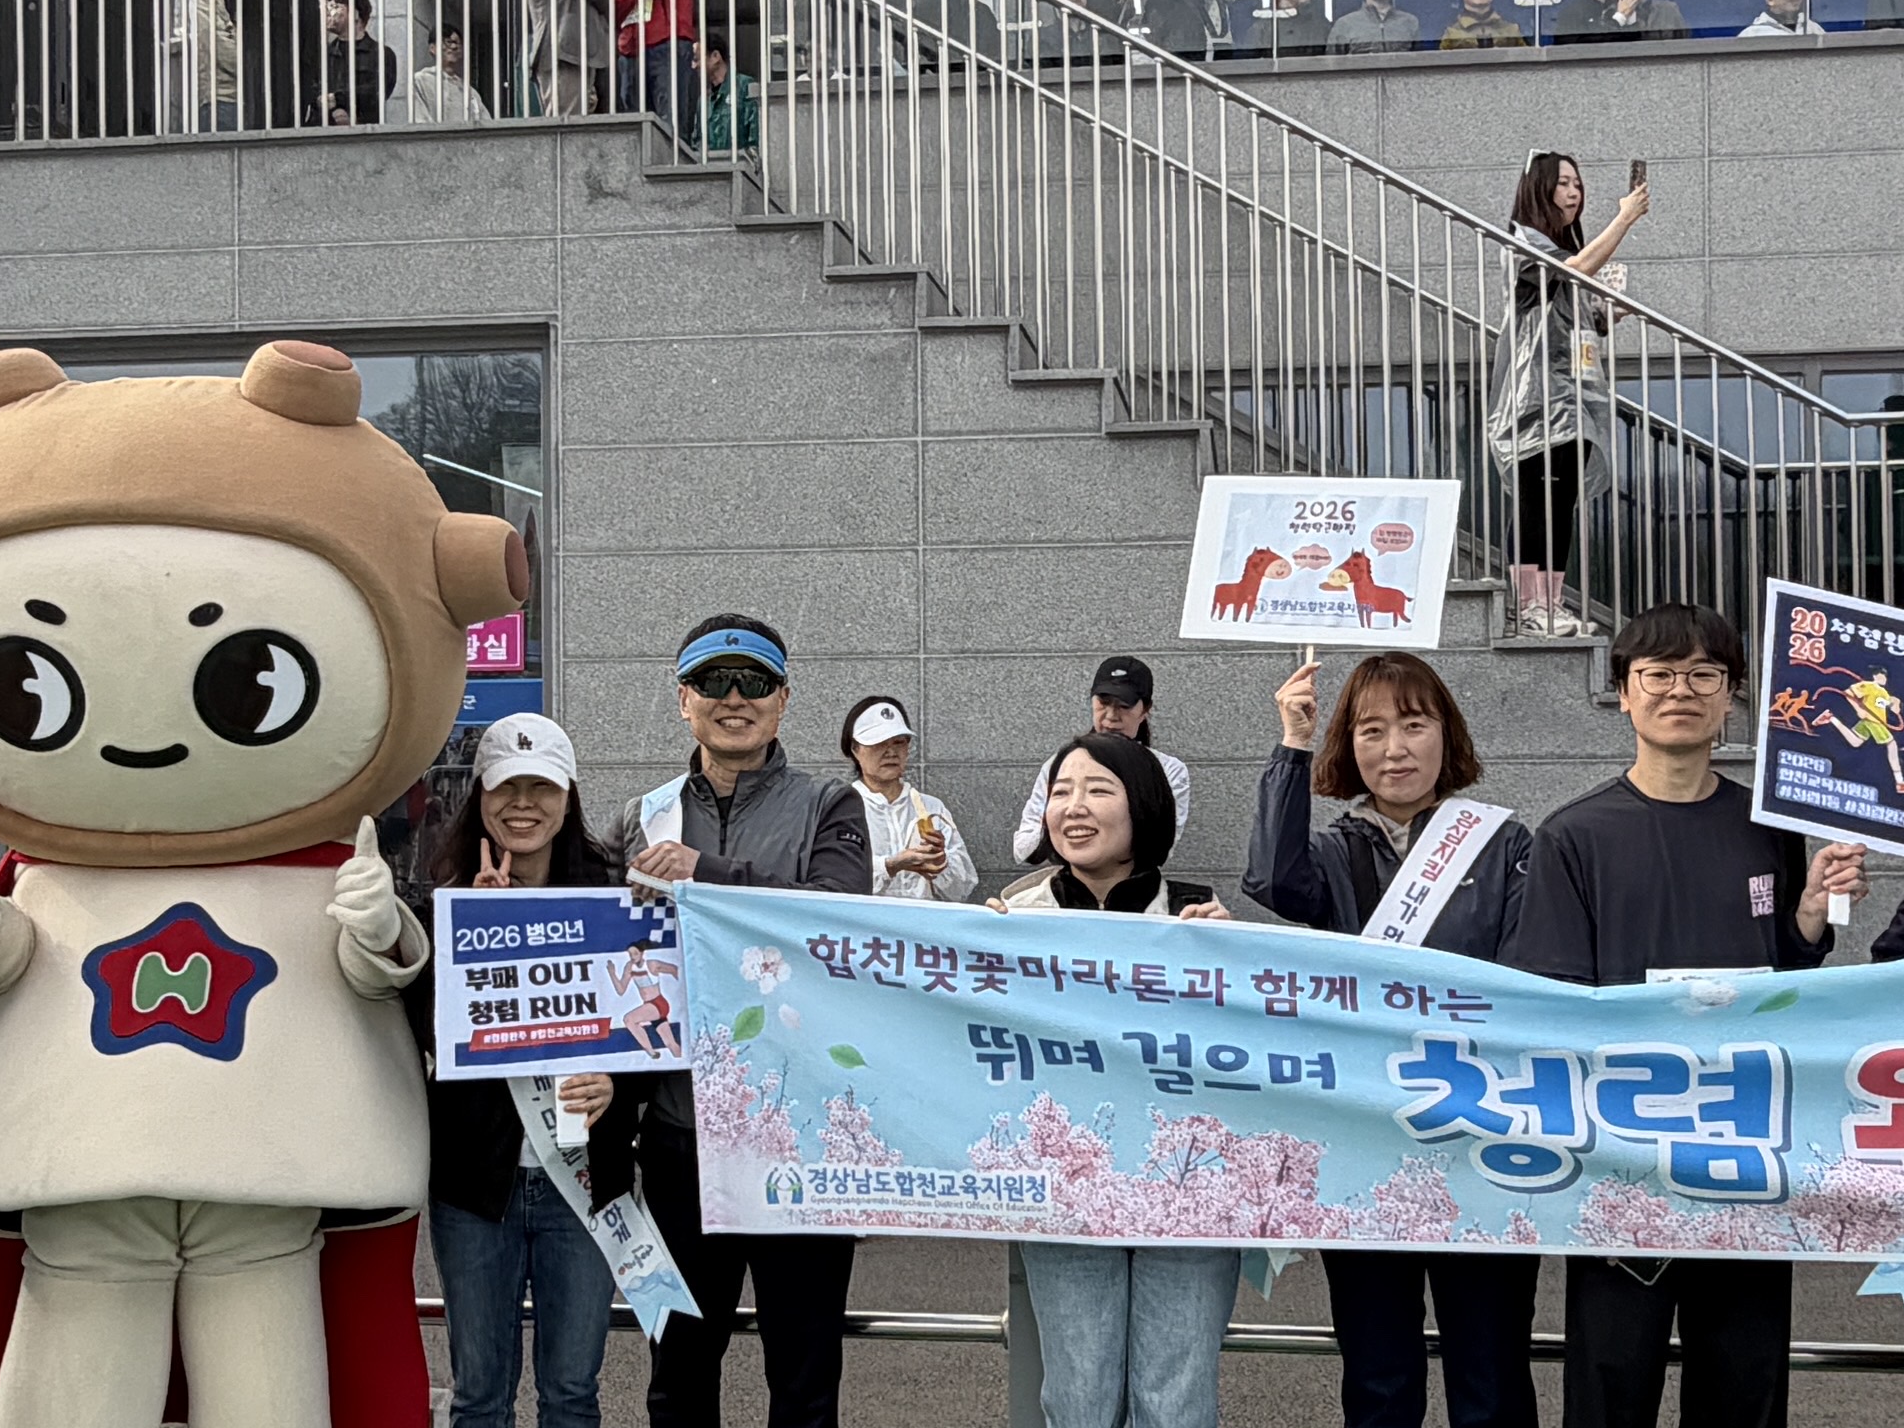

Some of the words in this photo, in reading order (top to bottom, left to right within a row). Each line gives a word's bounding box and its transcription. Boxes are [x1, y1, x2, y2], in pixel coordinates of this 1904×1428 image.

[1294, 501, 1357, 522] 2026
[1780, 751, 1826, 773] 2026
[1400, 881, 1431, 925] 내가
[456, 925, 521, 952] 2026
[525, 919, 585, 946] 병오년
[464, 964, 520, 992] 부패
[528, 959, 594, 987] OUT
[805, 933, 1231, 1007] 합천벚꽃마라톤과
[1249, 967, 1360, 1019] 함께
[1380, 980, 1494, 1024] 하는
[467, 997, 520, 1025] 청렴
[529, 991, 597, 1020] RUN
[966, 1022, 1106, 1083] 뛰며
[1121, 1029, 1337, 1096] 걸으며
[1392, 1035, 1779, 1198] 청렴
[807, 1166, 1047, 1204] 경상남도합천교육지원청
